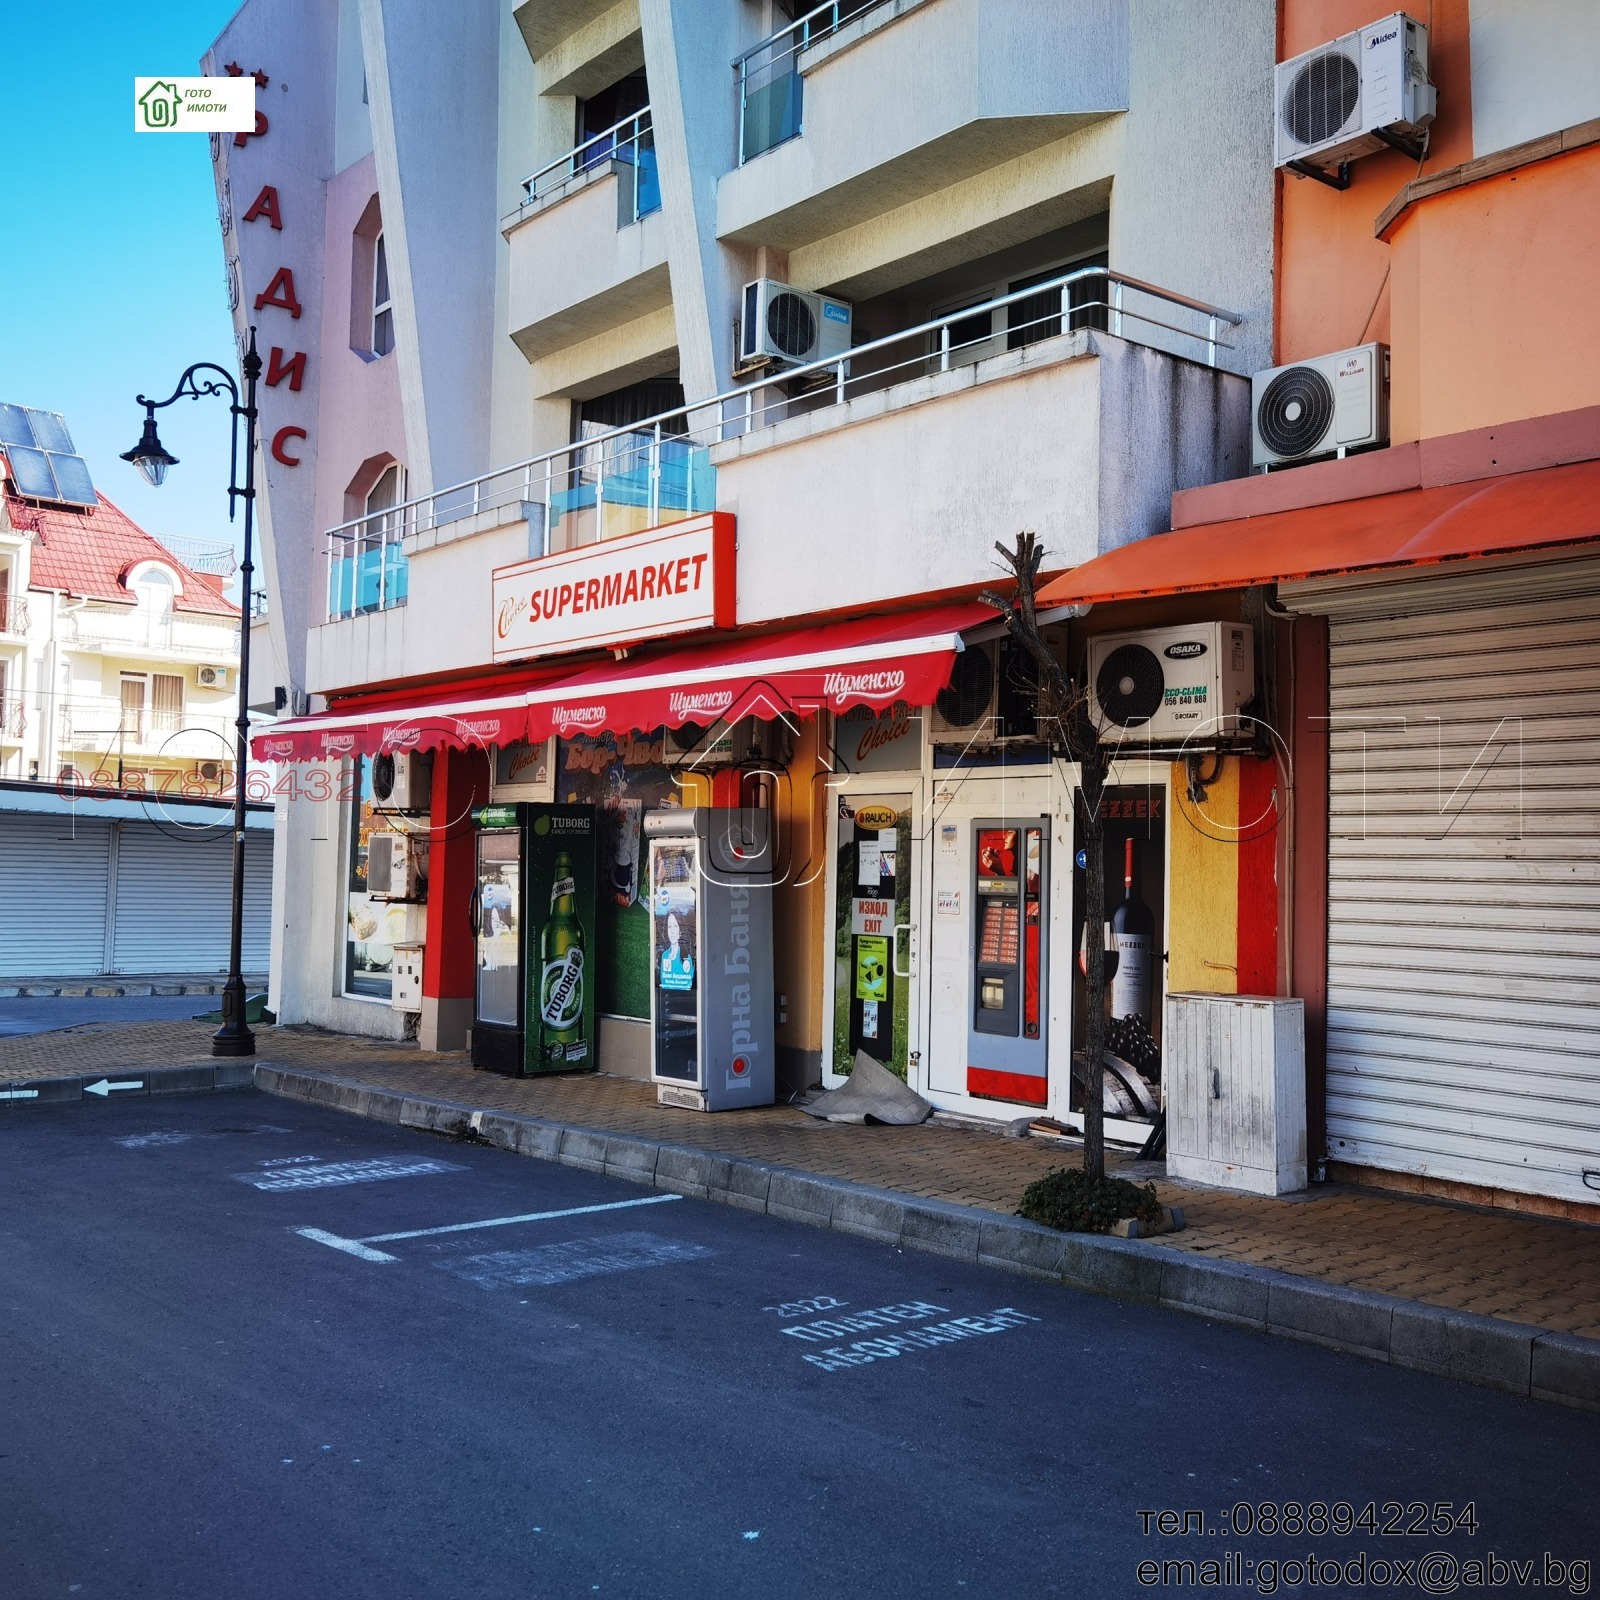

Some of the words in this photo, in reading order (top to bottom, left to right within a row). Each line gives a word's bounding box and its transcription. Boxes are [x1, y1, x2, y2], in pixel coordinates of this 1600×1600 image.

[1366, 31, 1398, 49] Midea
[529, 553, 708, 623] SUPERMARKET
[1169, 644, 1201, 655] OSAKA
[824, 670, 906, 705] Шуменско
[1163, 686, 1208, 698] ECO-CLIMA
[670, 690, 733, 720] Шуменско
[1164, 697, 1177, 706] 056
[1179, 696, 1192, 705] 840
[1194, 694, 1207, 704] 888
[456, 718, 501, 743] Шуменско
[551, 705, 608, 732] Шуменско
[321, 733, 355, 752] Шуменско
[382, 727, 421, 748] Шуменско
[856, 719, 912, 762] Choice
[508, 748, 541, 780] Choice
[865, 812, 892, 823] RAUCH
[1079, 799, 1162, 818] EZZEK
[551, 817, 590, 829] TUBORG
[858, 900, 888, 917] ИЗХОД
[723, 876, 751, 975] Баня
[863, 918, 882, 933] EXIT
[1119, 941, 1146, 949] MEZZE
[546, 965, 580, 1021] TUBORG
[724, 981, 759, 1091] Горна
[761, 1295, 851, 1319] 2022
[779, 1301, 951, 1343] ПЛАТЕН
[802, 1307, 1043, 1373] АБОНАМЕНТ
